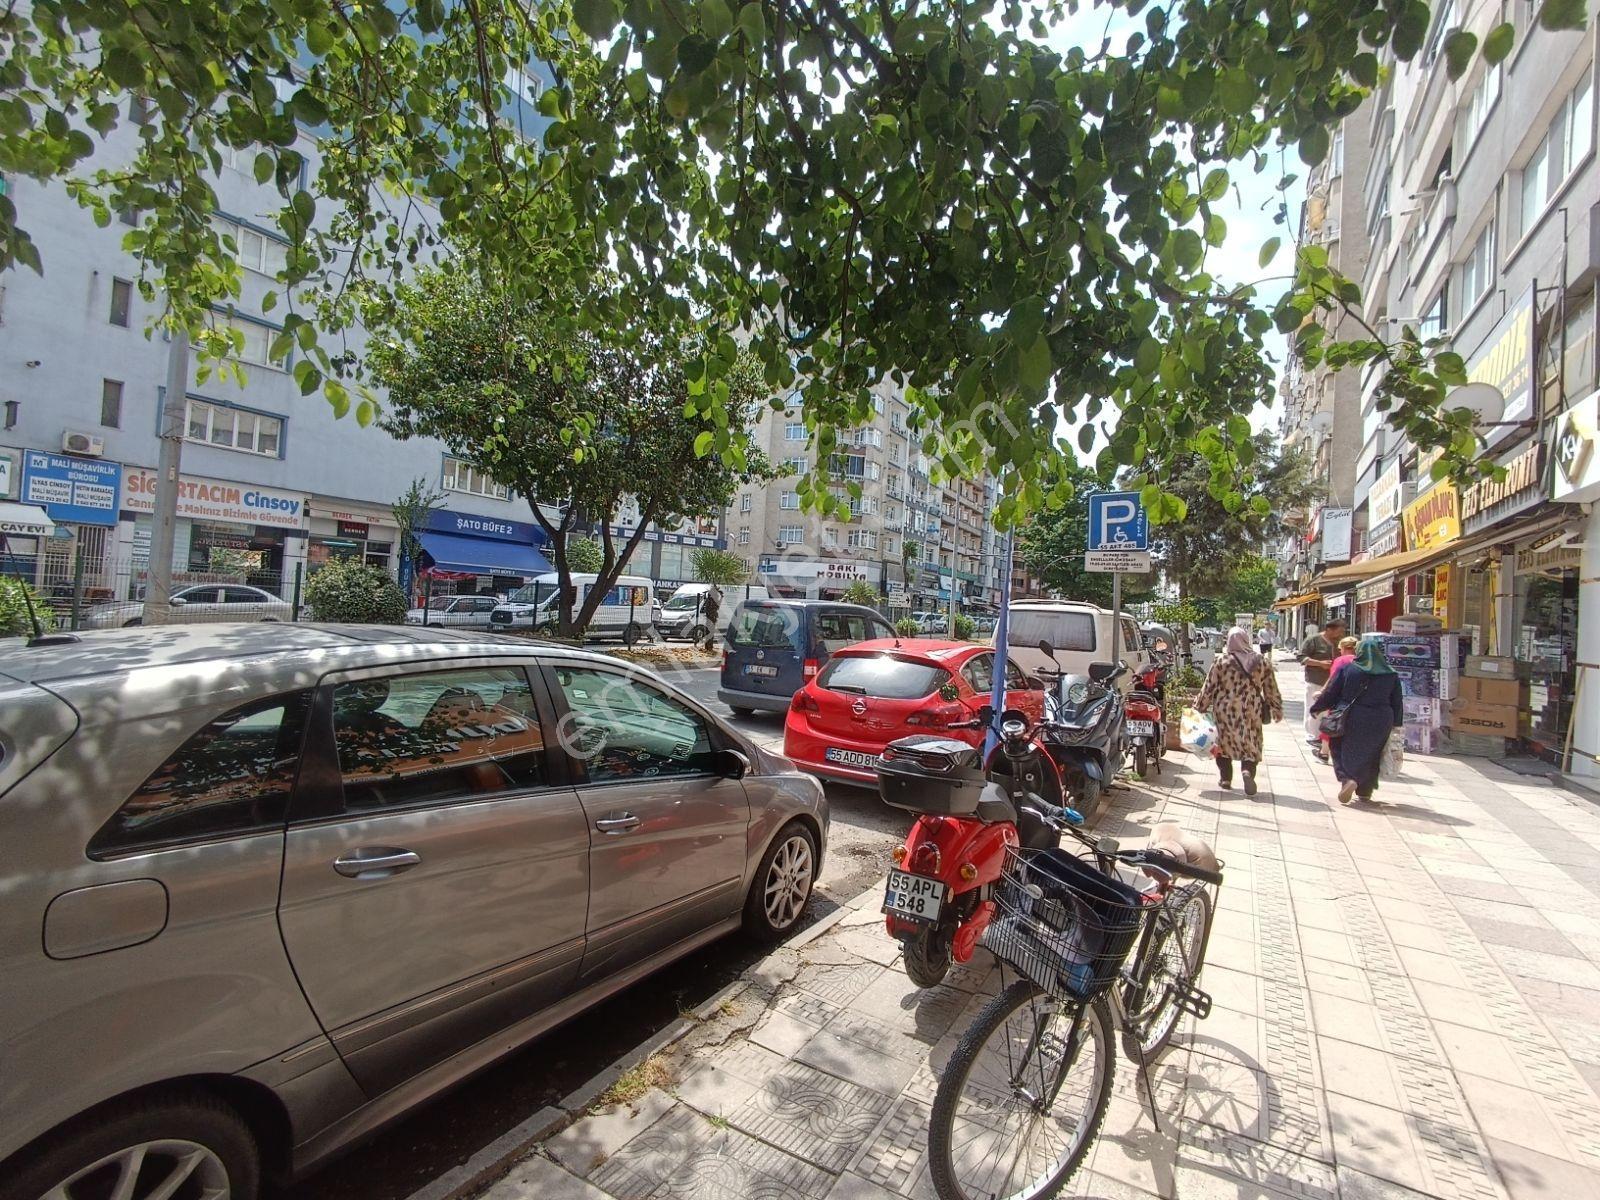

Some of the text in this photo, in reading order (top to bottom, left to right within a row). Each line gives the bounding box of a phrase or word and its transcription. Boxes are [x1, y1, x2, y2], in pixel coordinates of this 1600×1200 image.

[51, 458, 70, 468] MALİ
[71, 461, 116, 475] MÜŞAVİRLİK
[68, 471, 99, 482] BÜROSU
[127, 471, 300, 514] SİGRTACIM Cinsoy
[184, 504, 221, 516] Malınız
[222, 508, 257, 520] Bizimle
[259, 513, 298, 526] Güvende
[1102, 500, 1135, 544] P
[1326, 510, 1351, 520] Eylül
[457, 518, 513, 535] ŞATO BÜFE 2
[831, 749, 843, 760] 55
[843, 751, 864, 764] ADD
[891, 873, 940, 900] 55 APL
[897, 892, 925, 913] 548
